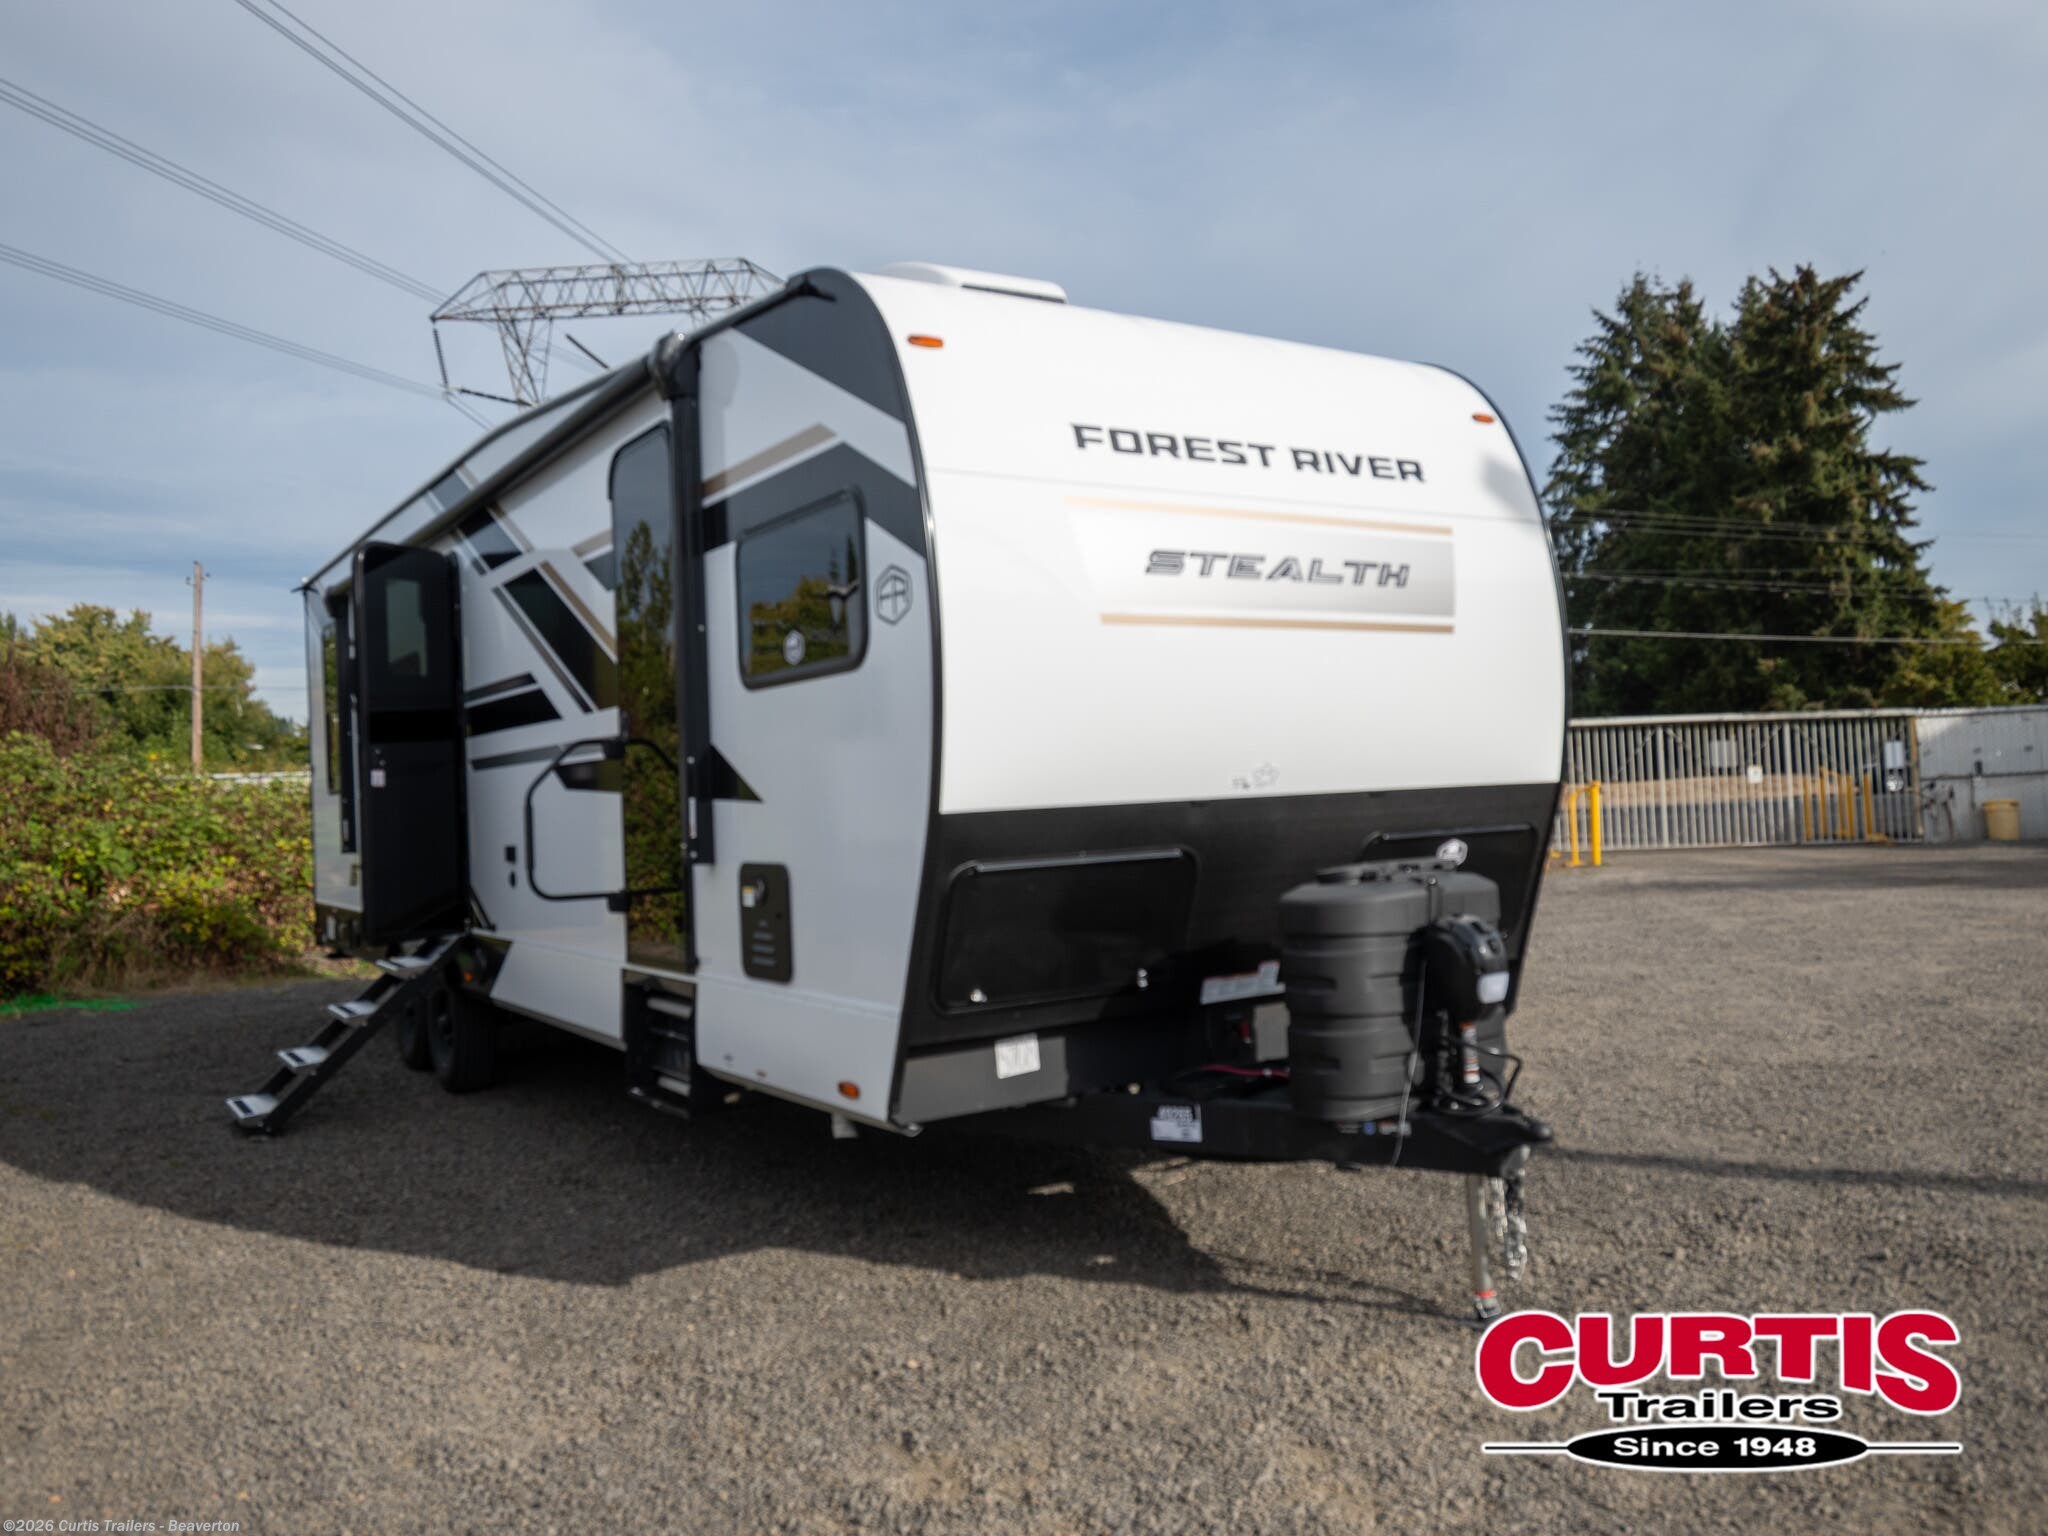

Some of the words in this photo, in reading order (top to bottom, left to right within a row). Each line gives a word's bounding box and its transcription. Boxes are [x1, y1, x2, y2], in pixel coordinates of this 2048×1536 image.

[1071, 423, 1275, 467] FOREST
[1290, 448, 1424, 482] RIVER
[1145, 550, 1410, 588] STEALTH
